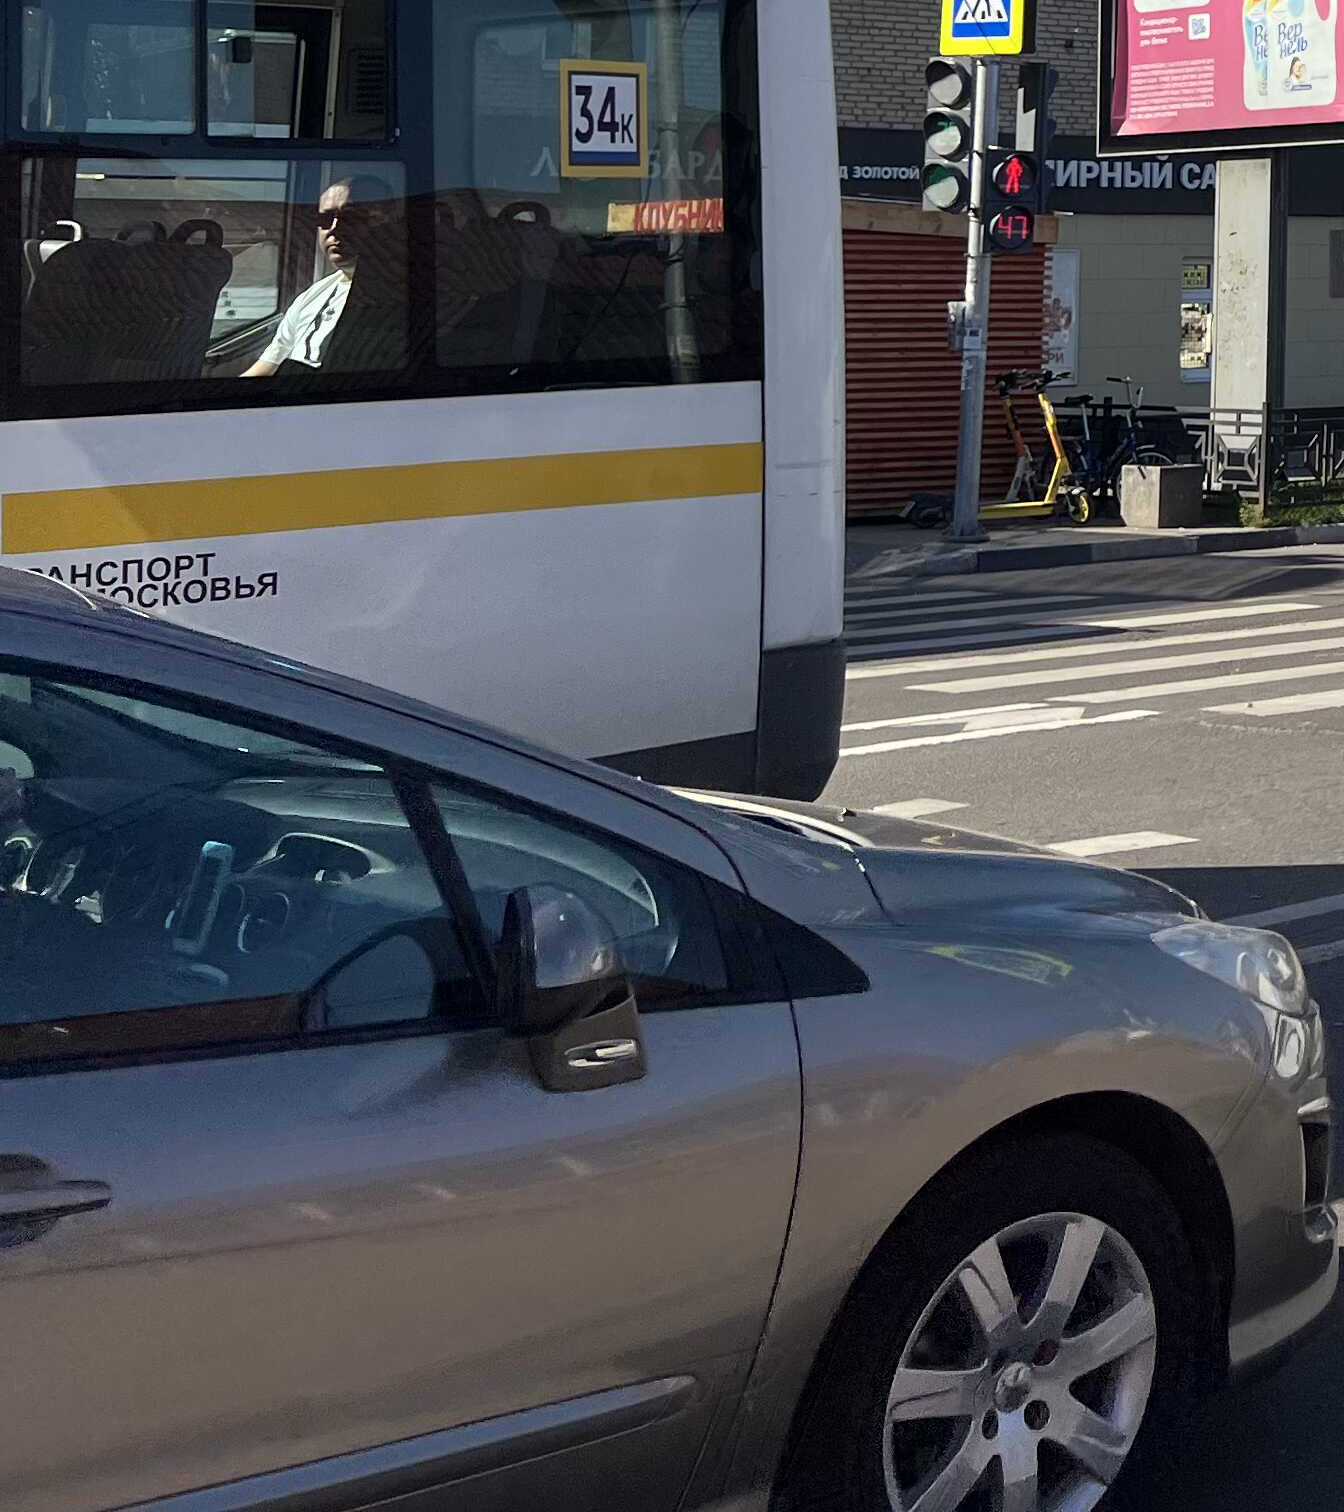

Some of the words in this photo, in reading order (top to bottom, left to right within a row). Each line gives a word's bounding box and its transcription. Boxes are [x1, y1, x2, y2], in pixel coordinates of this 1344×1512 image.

[1046, 155, 1173, 189] ИРНЫЙ
[998, 216, 1030, 240] 47
[28, 552, 216, 586] АНСПОРТ
[97, 572, 279, 608] ОСКОВЬЯ
